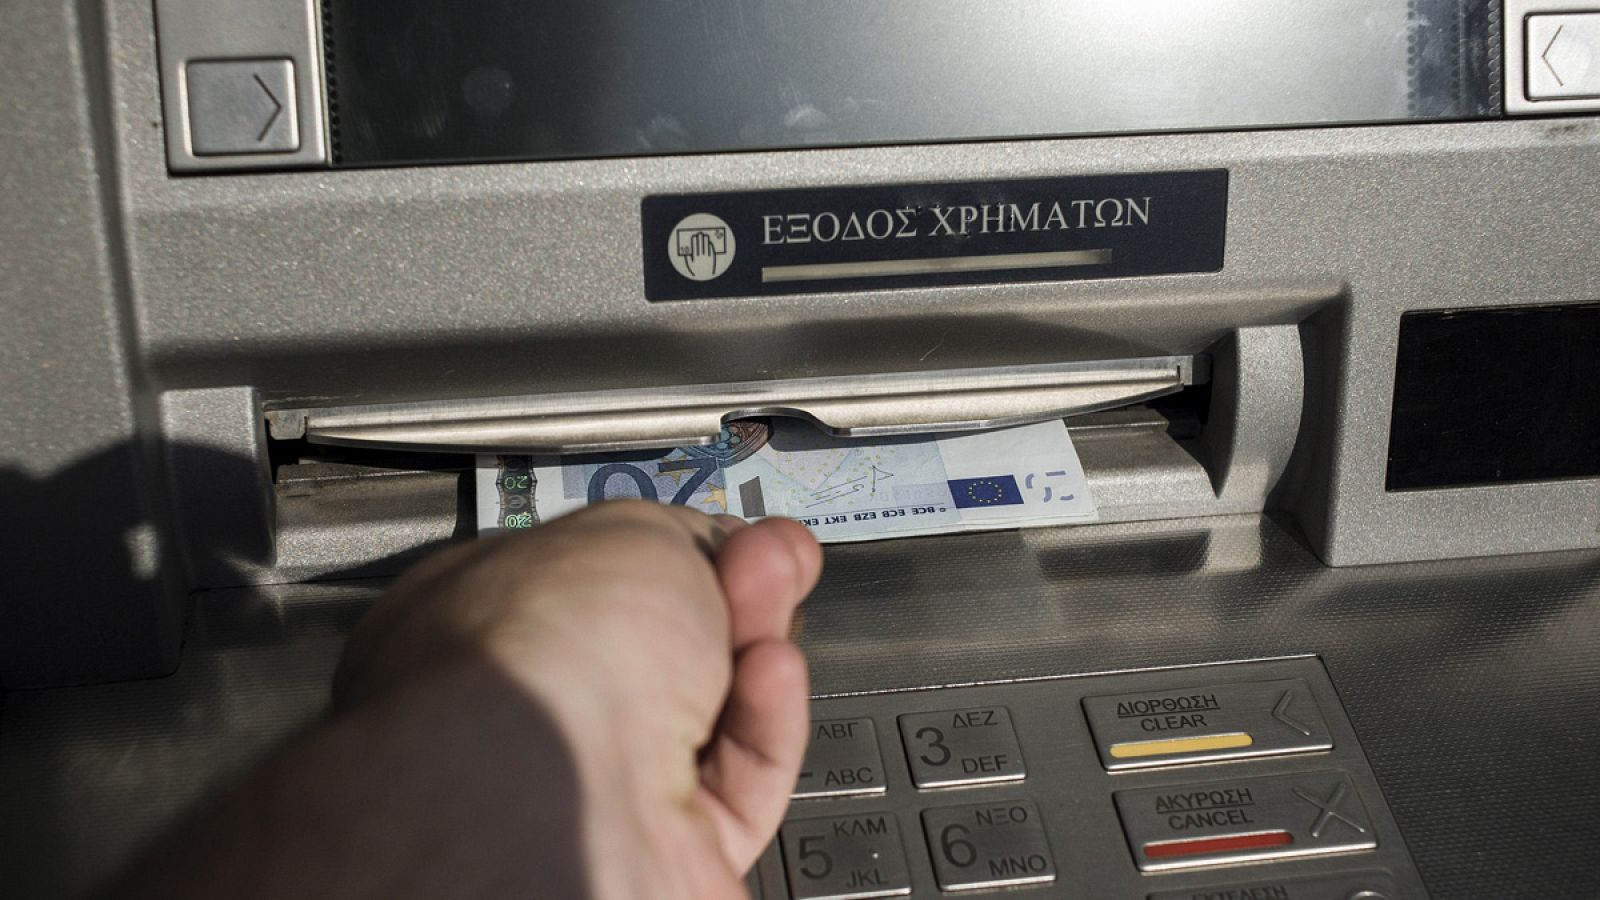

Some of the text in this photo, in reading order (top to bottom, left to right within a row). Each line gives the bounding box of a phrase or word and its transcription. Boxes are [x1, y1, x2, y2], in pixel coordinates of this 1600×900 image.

[762, 197, 1152, 245] ΕΞΟΔΟΣ ΧΡΗΜΑΤΩΝ
[824, 515, 848, 525] EKT
[854, 511, 877, 521] EZB
[882, 508, 906, 518] ECB
[911, 506, 936, 515] BCE
[1117, 694, 1219, 716] ΔΙΟΡΘΩΣΗ
[1141, 714, 1208, 732] CLEAR
[915, 727, 951, 767] 3
[961, 754, 1009, 774] DEF
[824, 766, 875, 787] ABC
[1156, 788, 1253, 812] ΑΚΥΡΩΣΗ
[1168, 809, 1255, 830] CANCEL
[940, 823, 977, 868] 6
[800, 835, 832, 880] 5
[988, 854, 1048, 877] MNO
[846, 868, 889, 888] JKL
